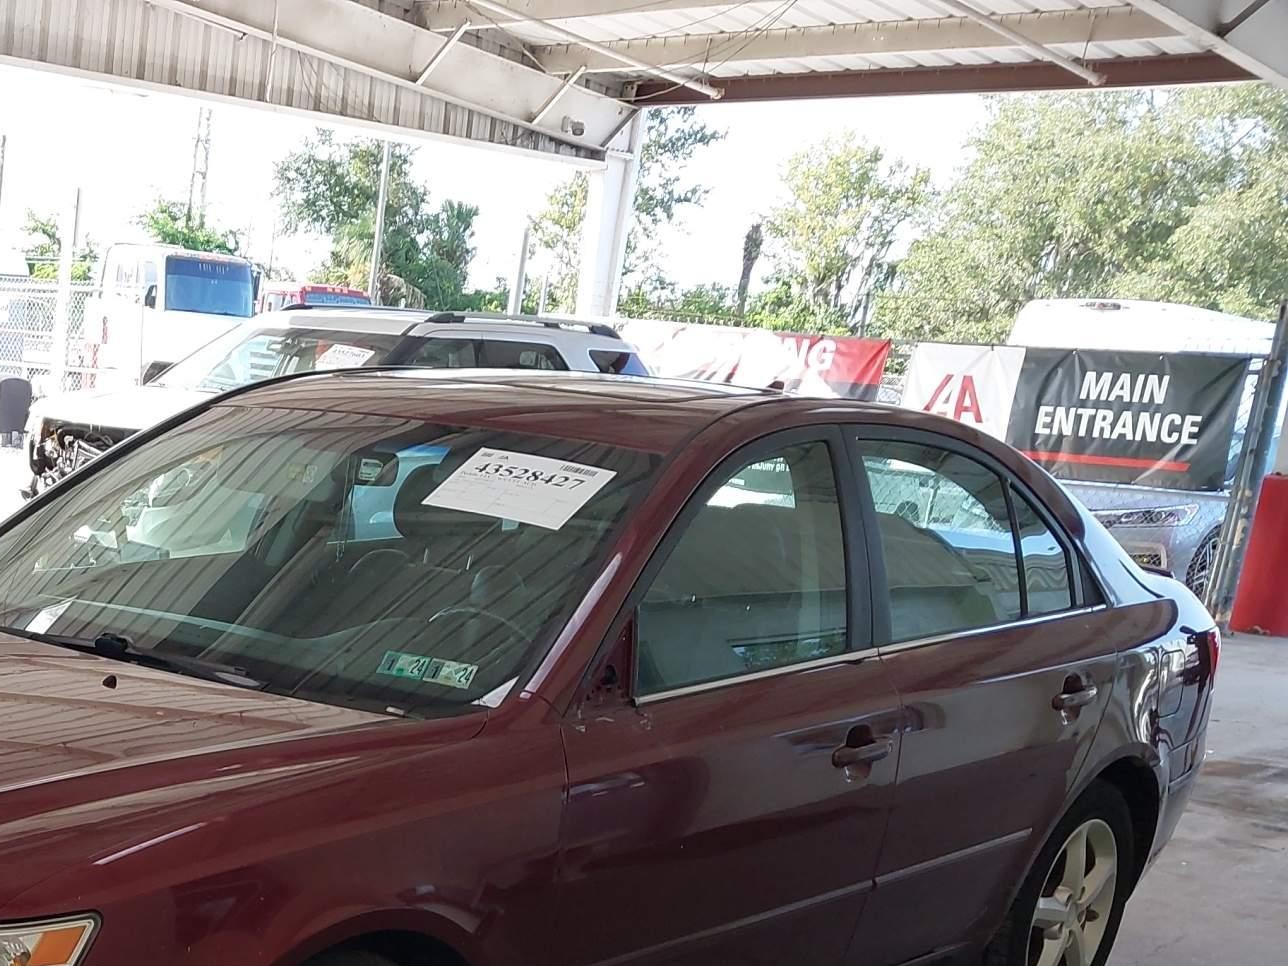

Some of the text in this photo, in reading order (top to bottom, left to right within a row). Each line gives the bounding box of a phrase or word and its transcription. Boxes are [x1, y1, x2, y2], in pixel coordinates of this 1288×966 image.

[1079, 371, 1170, 404] MAIN
[1034, 405, 1203, 445] ENTRANCE
[474, 462, 586, 491] 43528427
[409, 658, 427, 675] 24
[458, 667, 475, 684] 24
